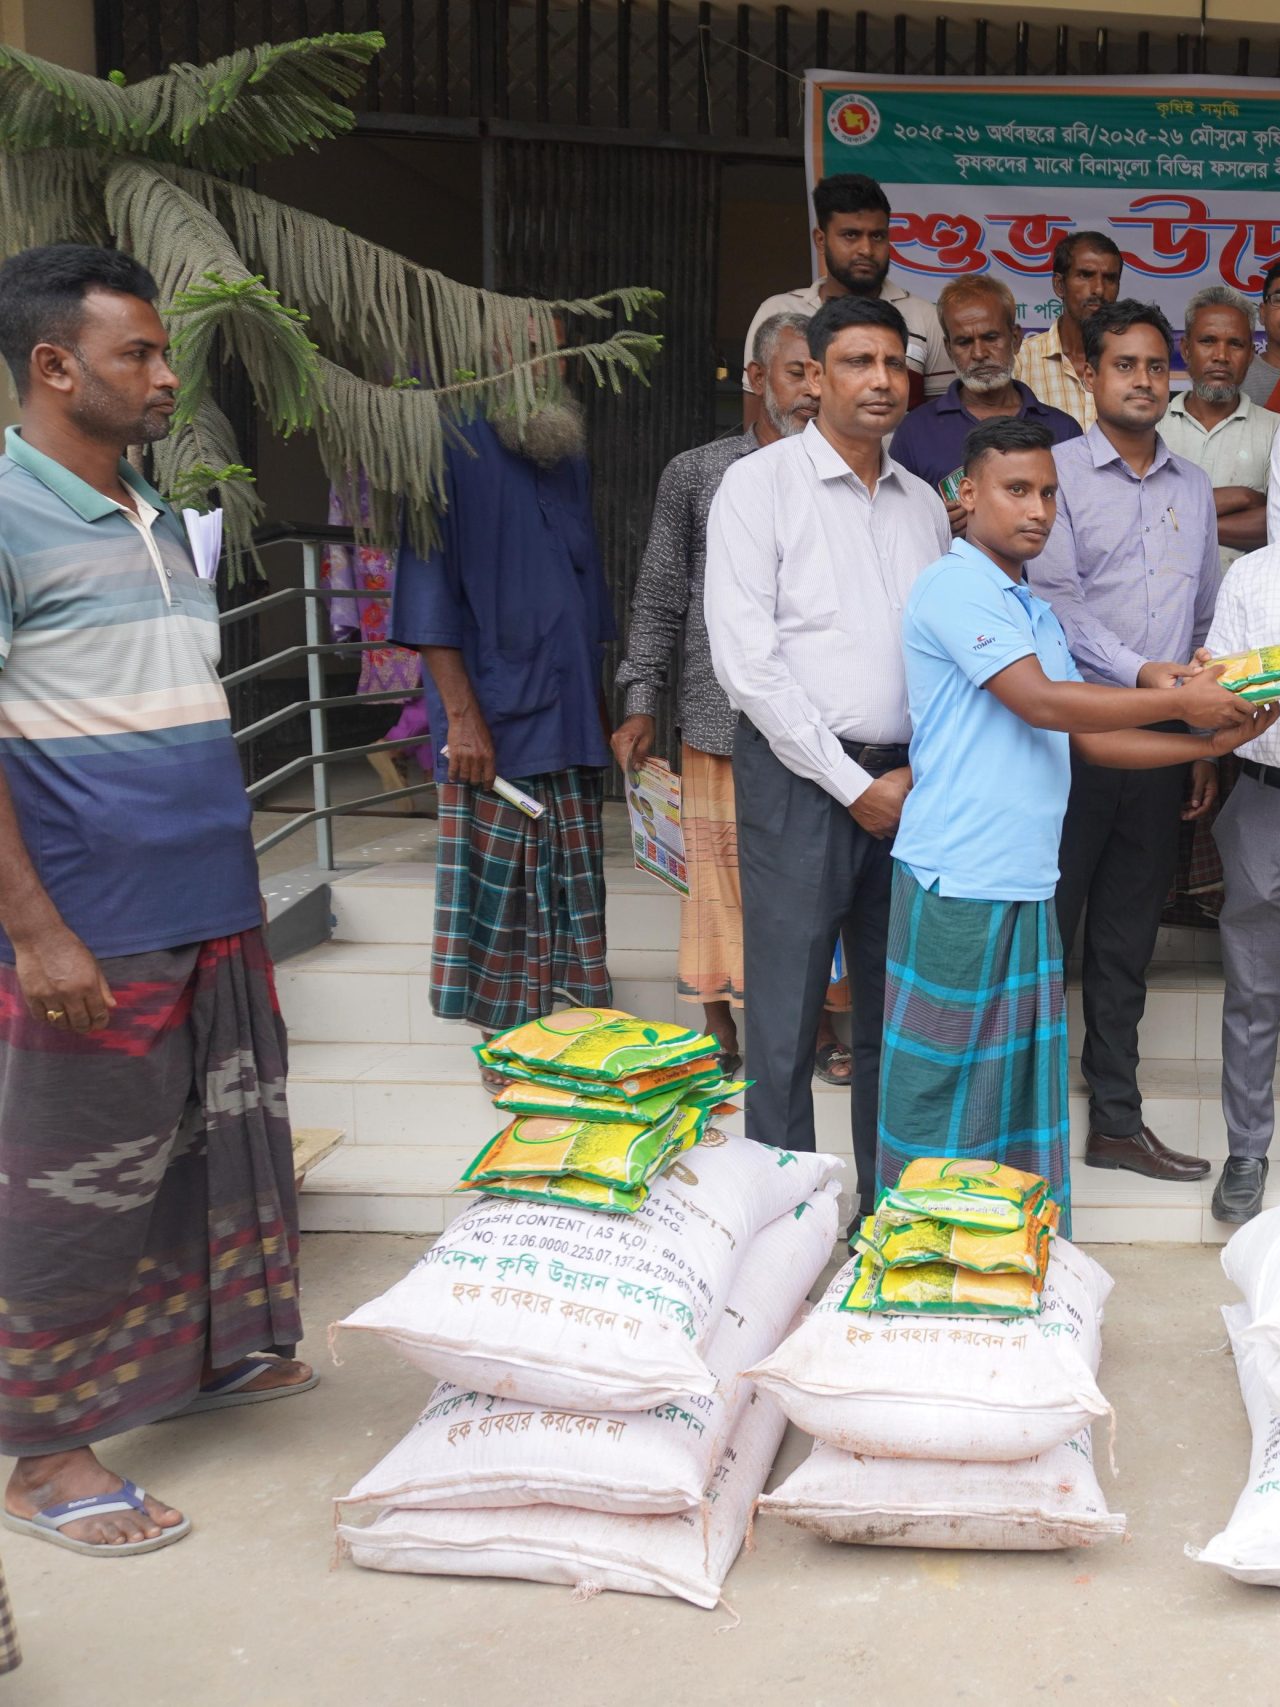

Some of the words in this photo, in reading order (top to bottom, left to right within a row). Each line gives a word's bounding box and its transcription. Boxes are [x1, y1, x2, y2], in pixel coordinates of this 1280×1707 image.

[894, 122, 980, 143] ২০২৫-২৬
[986, 120, 1056, 144] অর্থবছরে
[1061, 121, 1183, 146] রবি/২০২৫-২৬
[1190, 122, 1248, 150] মৌসুমে
[953, 154, 1028, 179] কৃষকদের
[1032, 156, 1073, 174] মাঝে
[1078, 153, 1151, 181] বিনামূল্যে
[1156, 154, 1205, 179] বিভিন্ন
[1209, 160, 1269, 179] ফসলের
[972, 636, 997, 651] TOMMY
[459, 1214, 513, 1233] OTASH
[515, 1214, 586, 1234] CONTENT
[496, 1252, 541, 1281] কৃষি
[549, 1259, 609, 1292] উন্নয়ন
[452, 1282, 484, 1305] হুক
[490, 1286, 554, 1315] ব্যবহার
[559, 1300, 619, 1328] করবেন
[623, 1315, 643, 1341] না
[846, 1325, 873, 1347] হুক
[881, 1327, 941, 1344] ব্যবহার
[947, 1328, 1005, 1348] করবেন
[1011, 1333, 1028, 1351] না
[448, 1420, 474, 1447] হুক
[478, 1411, 534, 1437] ব্যবহার
[540, 1410, 602, 1436] করবেন
[607, 1418, 628, 1442] না
